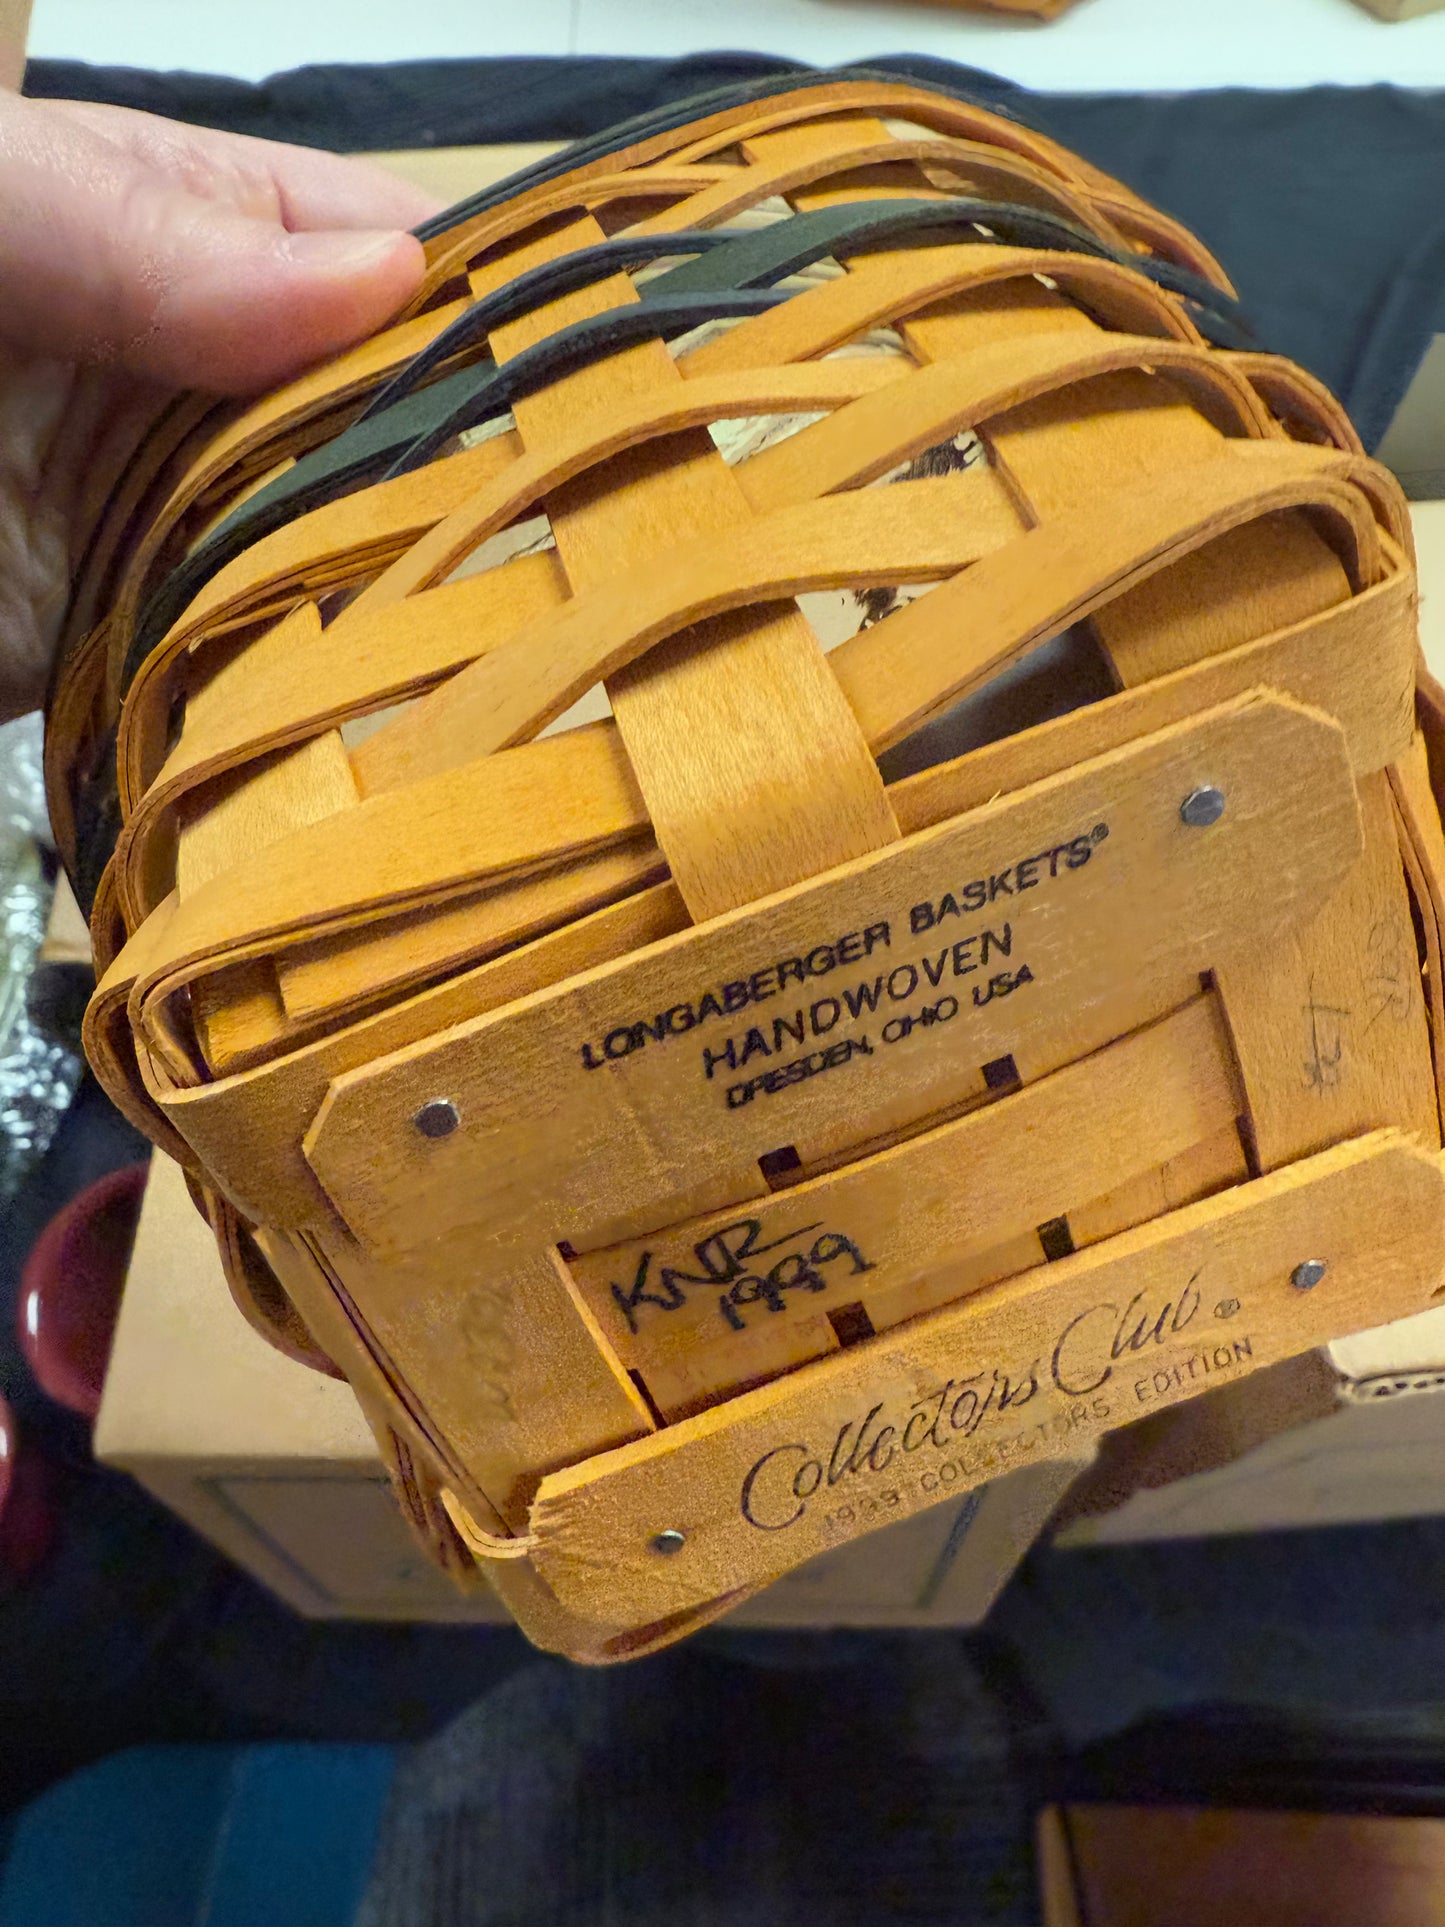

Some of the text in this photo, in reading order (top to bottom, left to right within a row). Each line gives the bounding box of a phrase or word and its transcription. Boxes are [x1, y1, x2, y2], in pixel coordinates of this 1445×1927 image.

[582, 920, 891, 1071] LONGABERGER
[702, 922, 1014, 1079] HANDWOVEN
[881, 995, 959, 1044] OHIO
[972, 963, 1035, 1008] USA
[719, 1232, 877, 1332] 1999
[1132, 1335, 1254, 1402] EDITION
